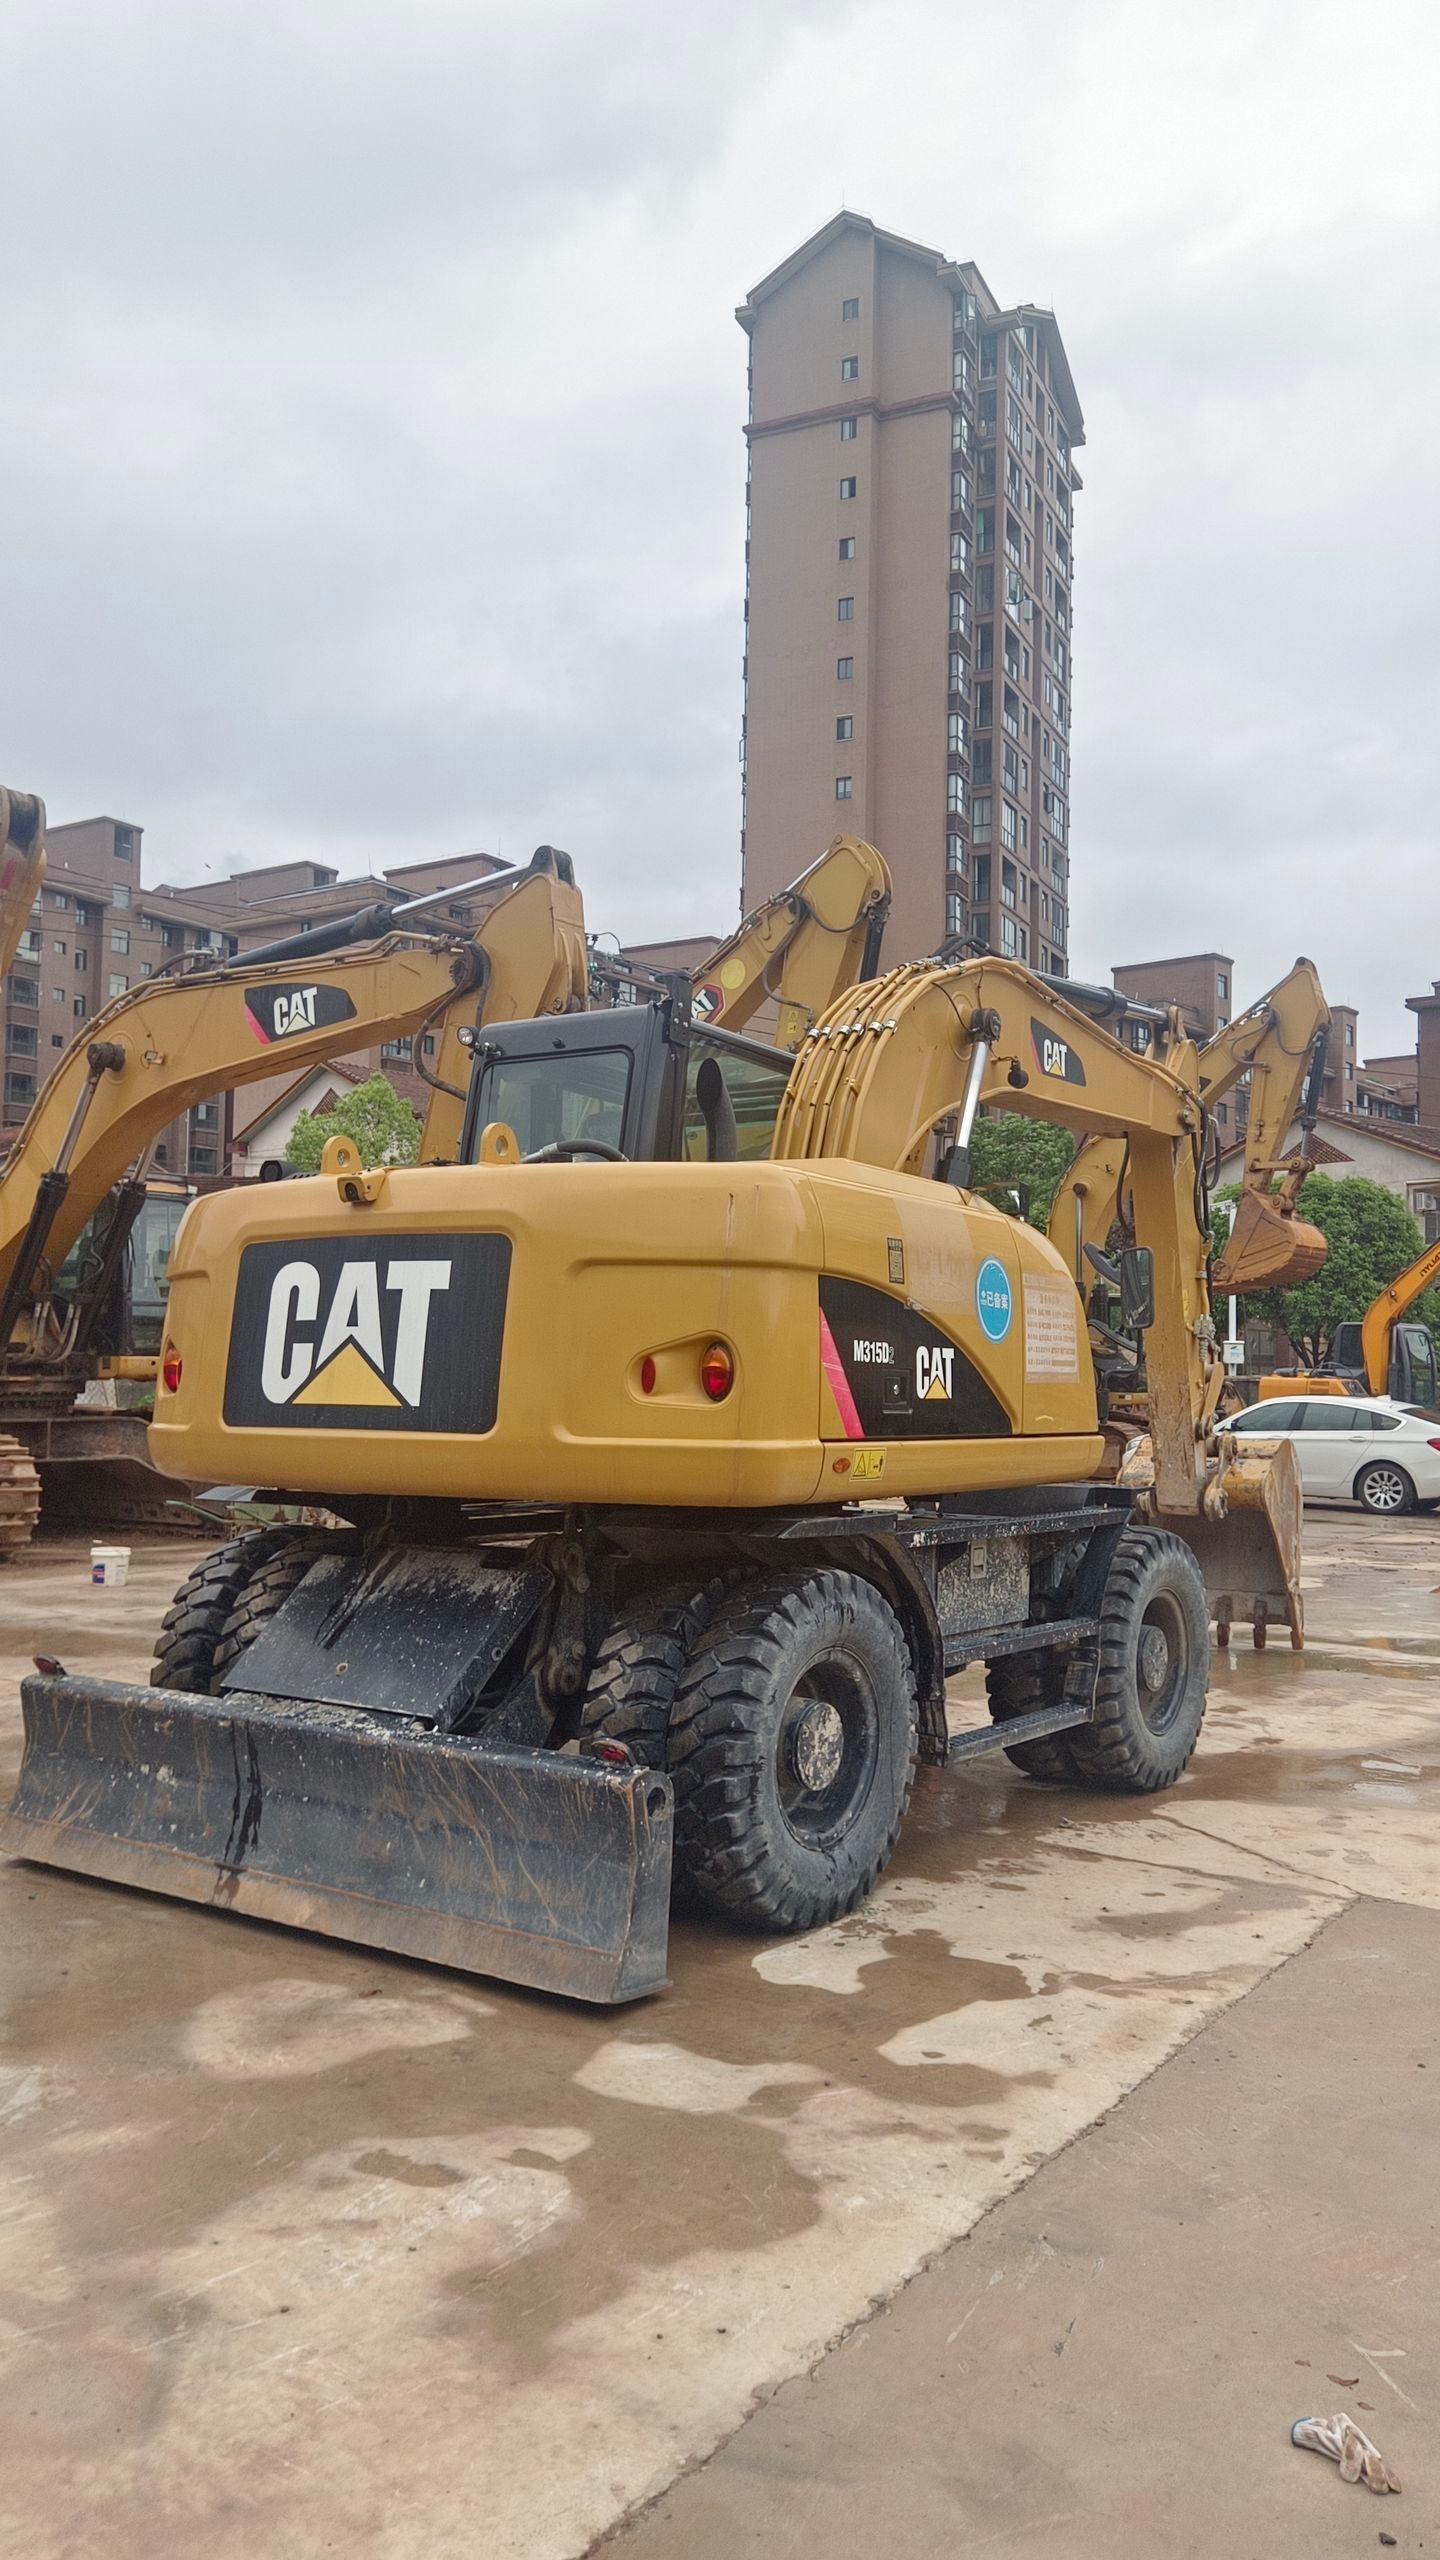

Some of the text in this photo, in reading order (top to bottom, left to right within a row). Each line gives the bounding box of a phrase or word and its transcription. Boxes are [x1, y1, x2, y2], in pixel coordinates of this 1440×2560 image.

[273, 986, 318, 1035] CAT
[691, 988, 715, 1019] AT
[1043, 1039, 1067, 1077] CAT
[261, 1260, 452, 1407] CAT
[853, 1340, 895, 1365] M315D2
[916, 1345, 955, 1400] CAT
